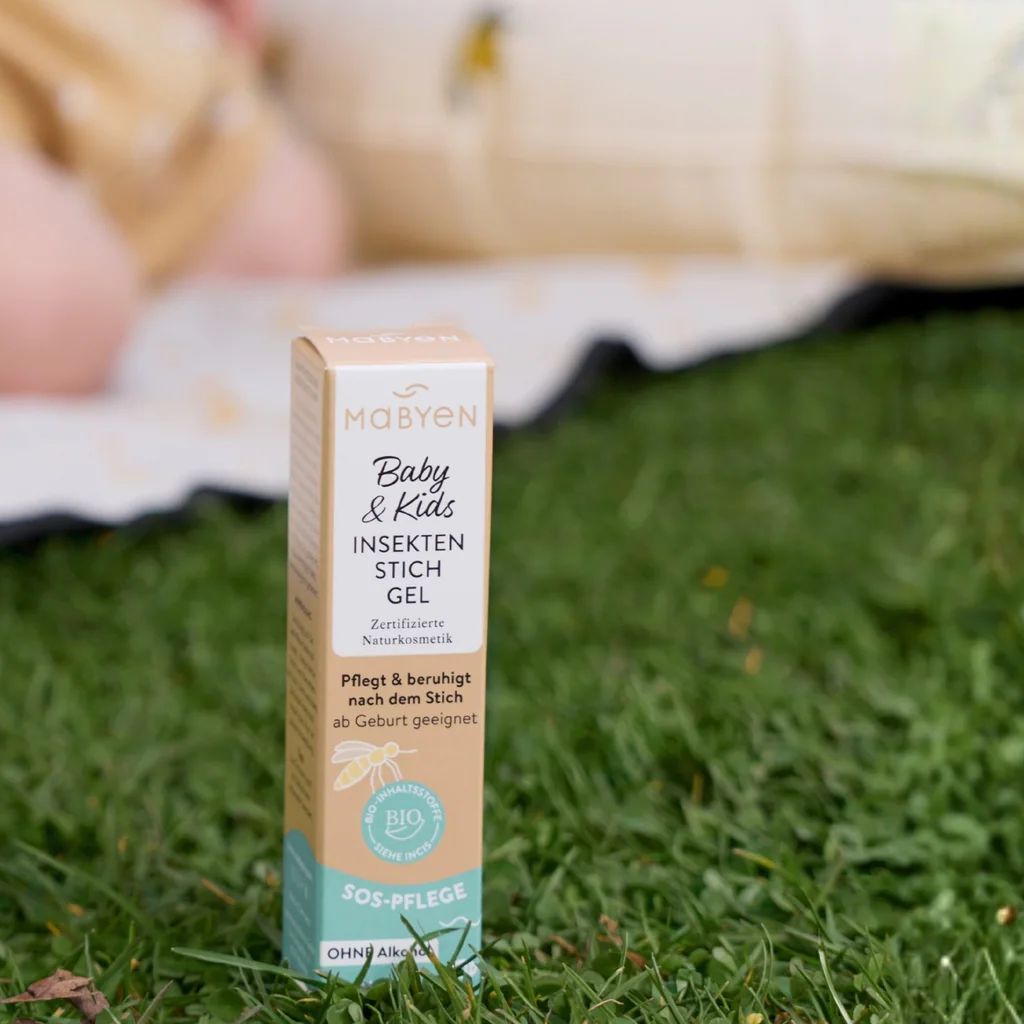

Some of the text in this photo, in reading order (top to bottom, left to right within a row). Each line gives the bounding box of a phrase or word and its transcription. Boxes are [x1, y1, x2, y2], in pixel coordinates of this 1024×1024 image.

[372, 455, 450, 494] Baby
[361, 491, 456, 524] & Kids
[353, 533, 464, 554] INSEKTEN
[375, 560, 442, 579] STICH
[387, 586, 430, 604] GEL
[370, 618, 445, 630] Zertifizierte
[362, 633, 453, 646] Naturkosmetik
[341, 672, 472, 690] Pflegt & beruhigt
[348, 691, 464, 706] nach dem Stich
[332, 711, 479, 730] ab Geburt geeignet
[385, 808, 422, 826] BIO
[341, 882, 468, 911] SOS-PFLEGE
